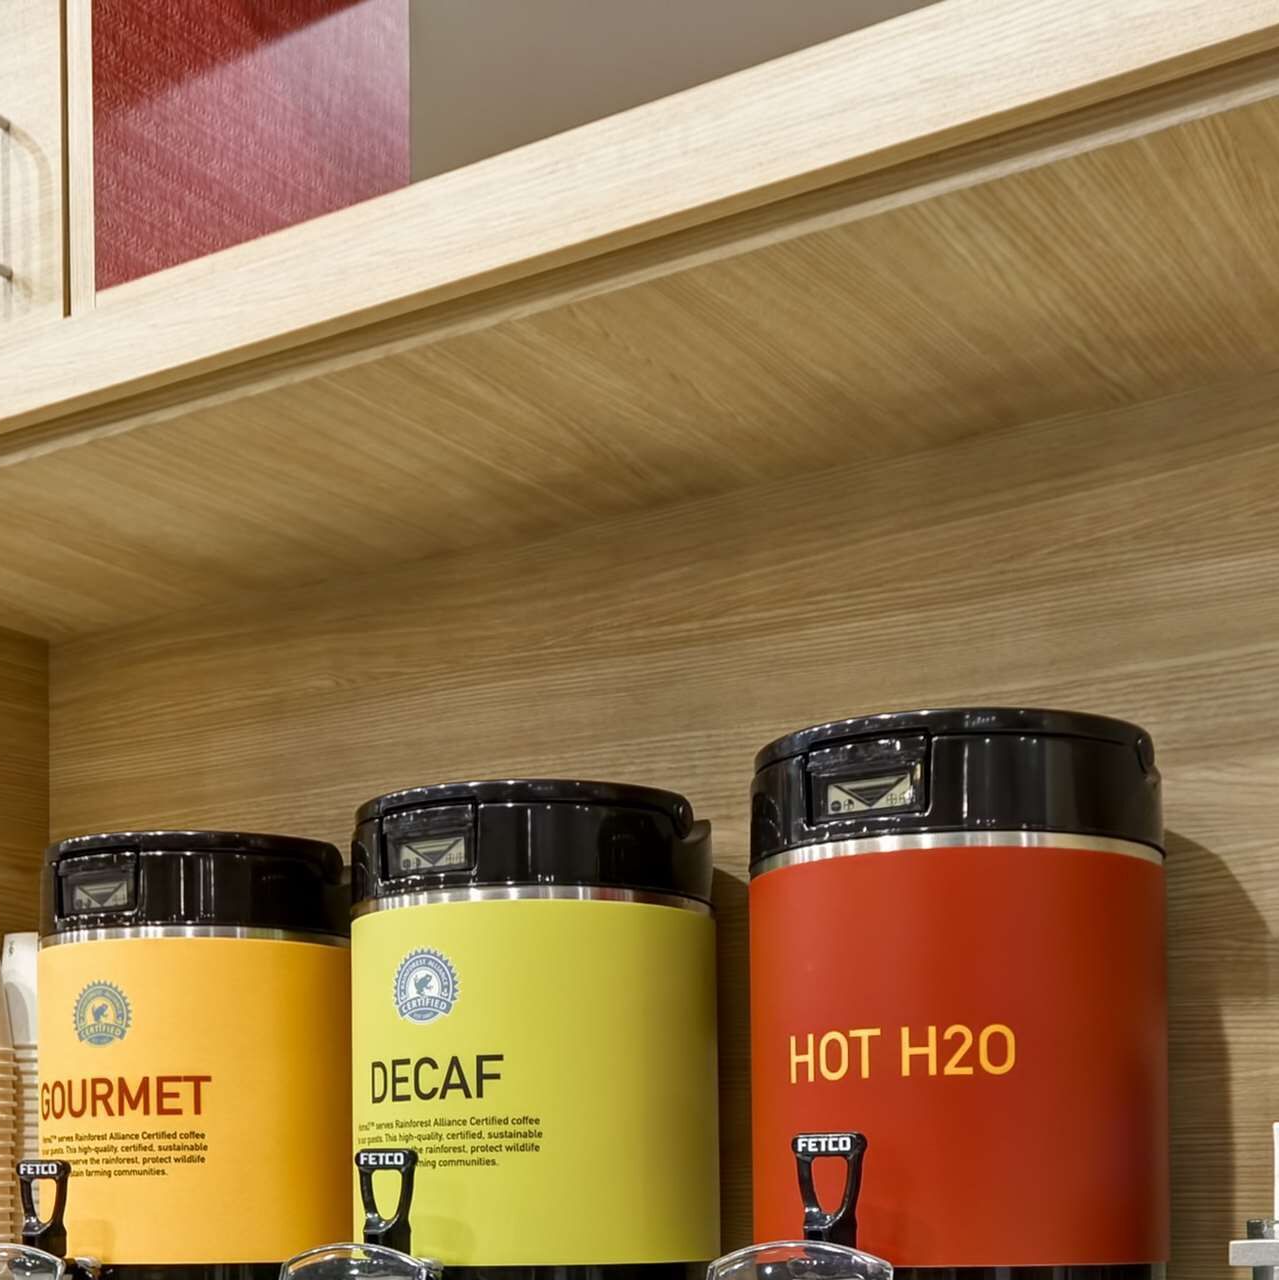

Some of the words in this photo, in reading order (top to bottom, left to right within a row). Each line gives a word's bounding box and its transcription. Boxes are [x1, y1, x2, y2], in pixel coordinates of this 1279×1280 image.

[401, 997, 447, 1012] CERTIFIED
[790, 1028, 881, 1084] HOT
[901, 1024, 1016, 1076] H2O
[371, 1054, 504, 1104] DECAF
[41, 1075, 212, 1120] GOURMET
[395, 1119, 432, 1128] Rainforest
[433, 1117, 468, 1127] Alliance
[469, 1116, 509, 1126] Certified
[511, 1116, 540, 1125] coffee
[75, 1132, 108, 1141] Rainforest
[109, 1132, 140, 1141] Alliance
[141, 1130, 177, 1140] Certified
[179, 1131, 205, 1140] coffee
[487, 1129, 543, 1139] sustainable
[158, 1143, 208, 1152] sustainable
[425, 1143, 469, 1154] rainforest,
[470, 1143, 503, 1154] protect
[504, 1142, 540, 1152] wildlife
[797, 1137, 851, 1152] FETCO
[142, 1155, 172, 1166] protect
[173, 1154, 205, 1164] wildlife
[359, 1152, 405, 1166] FETCO
[438, 1157, 499, 1168] communities.
[20, 1163, 58, 1175] FETCO
[86, 1168, 112, 1179] farming
[113, 1168, 168, 1177] communities.
